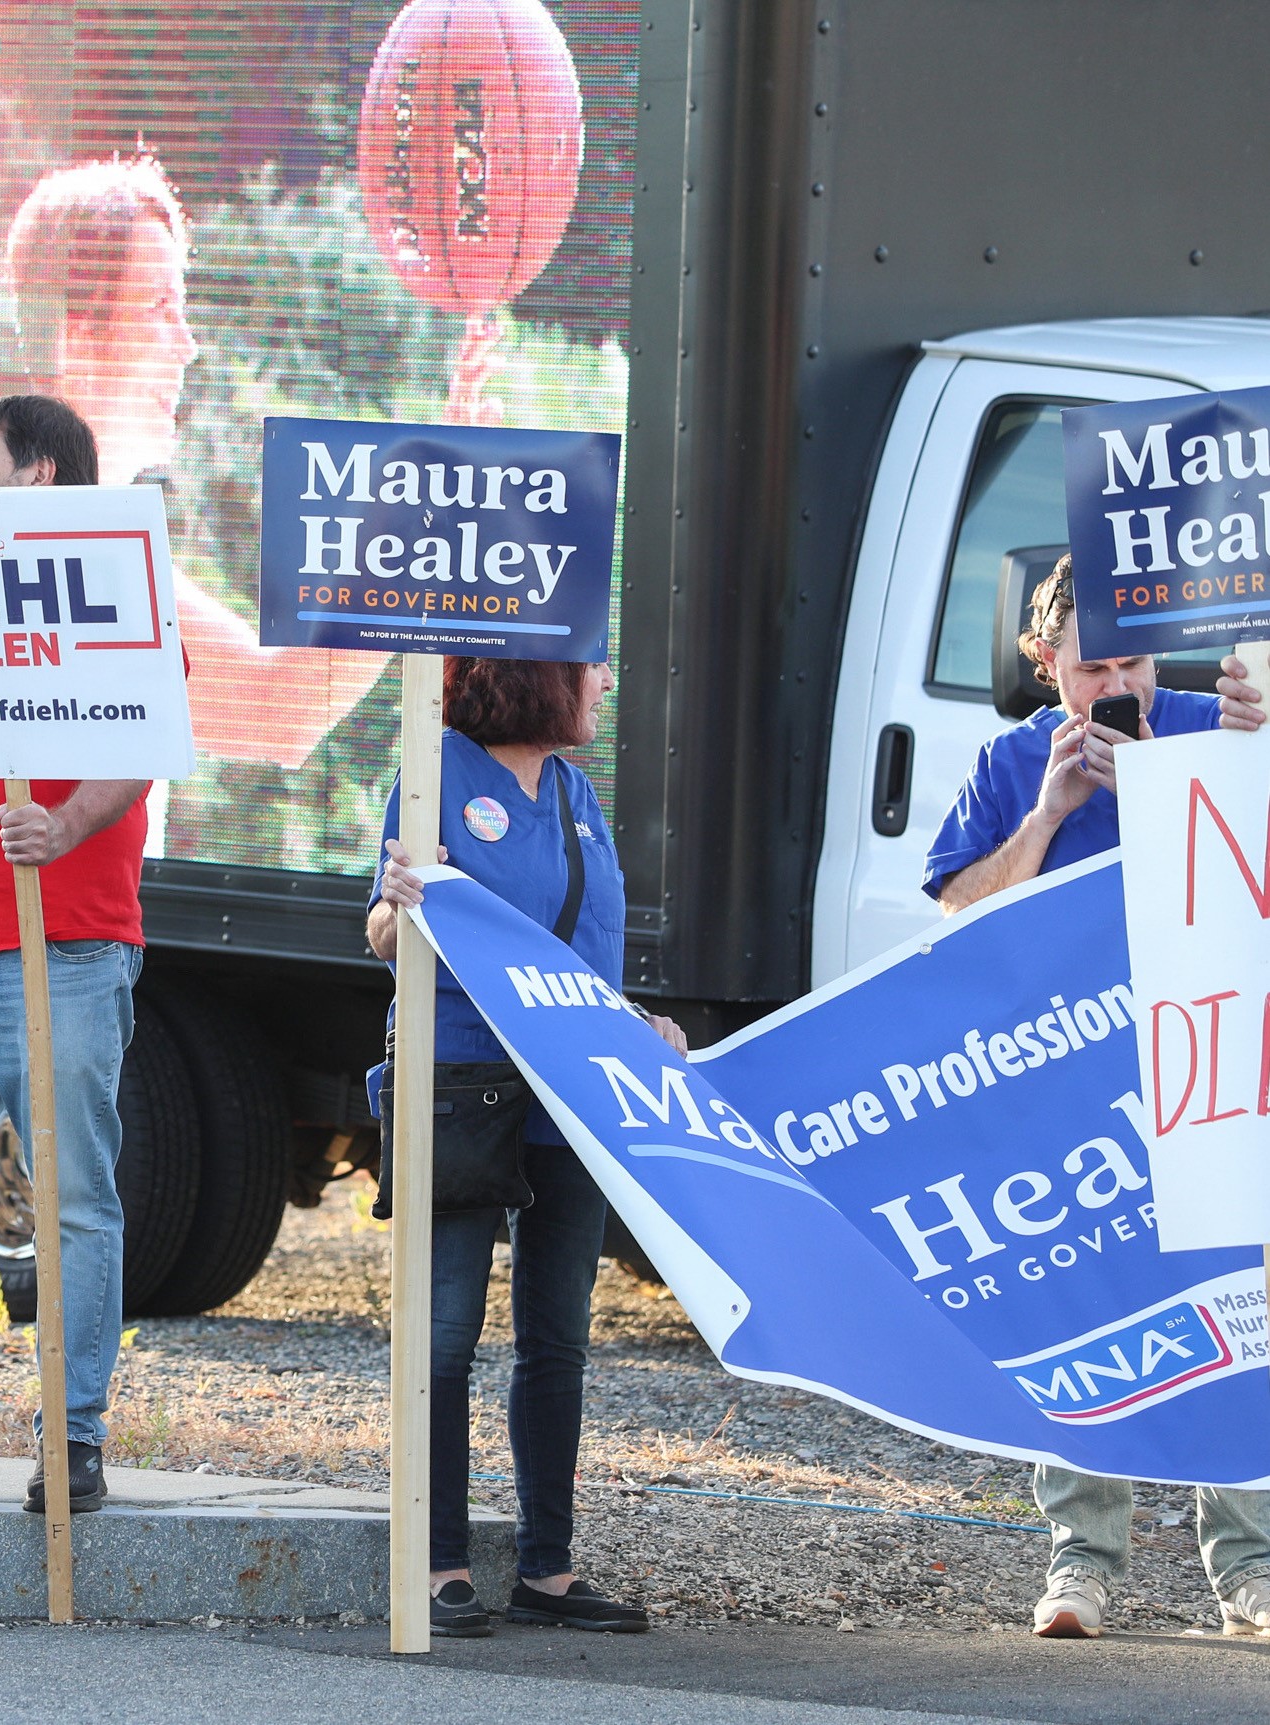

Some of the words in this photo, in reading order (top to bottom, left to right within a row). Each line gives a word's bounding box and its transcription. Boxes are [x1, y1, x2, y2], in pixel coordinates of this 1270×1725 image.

[1098, 423, 1270, 495] Mau
[299, 441, 568, 515] Maura
[298, 515, 578, 605] Healey
[298, 586, 351, 606] FOR
[363, 588, 521, 615] GOVERNOR
[1114, 584, 1170, 608] FOR
[1182, 572, 1266, 601] GOVER
[439, 635, 466, 643] HEALEY
[466, 637, 506, 645] COMMITTEE
[1182, 627, 1196, 636] PAID
[1196, 625, 1207, 634] FOR
[1208, 624, 1215, 632] BY
[1215, 623, 1226, 631] THE
[1227, 620, 1252, 630] MAURA
[470, 807, 504, 819] Maura
[471, 816, 506, 830] Healey
[505, 965, 642, 1020] Nurs
[773, 1090, 891, 1165] Care
[881, 982, 1135, 1122] Profession
[587, 1056, 807, 1180] Ma
[924, 1275, 1001, 1309] OR
[1014, 1329, 1196, 1404] MNA
[1165, 1315, 1186, 1329] SM
[52, 1523, 65, 1539] F
